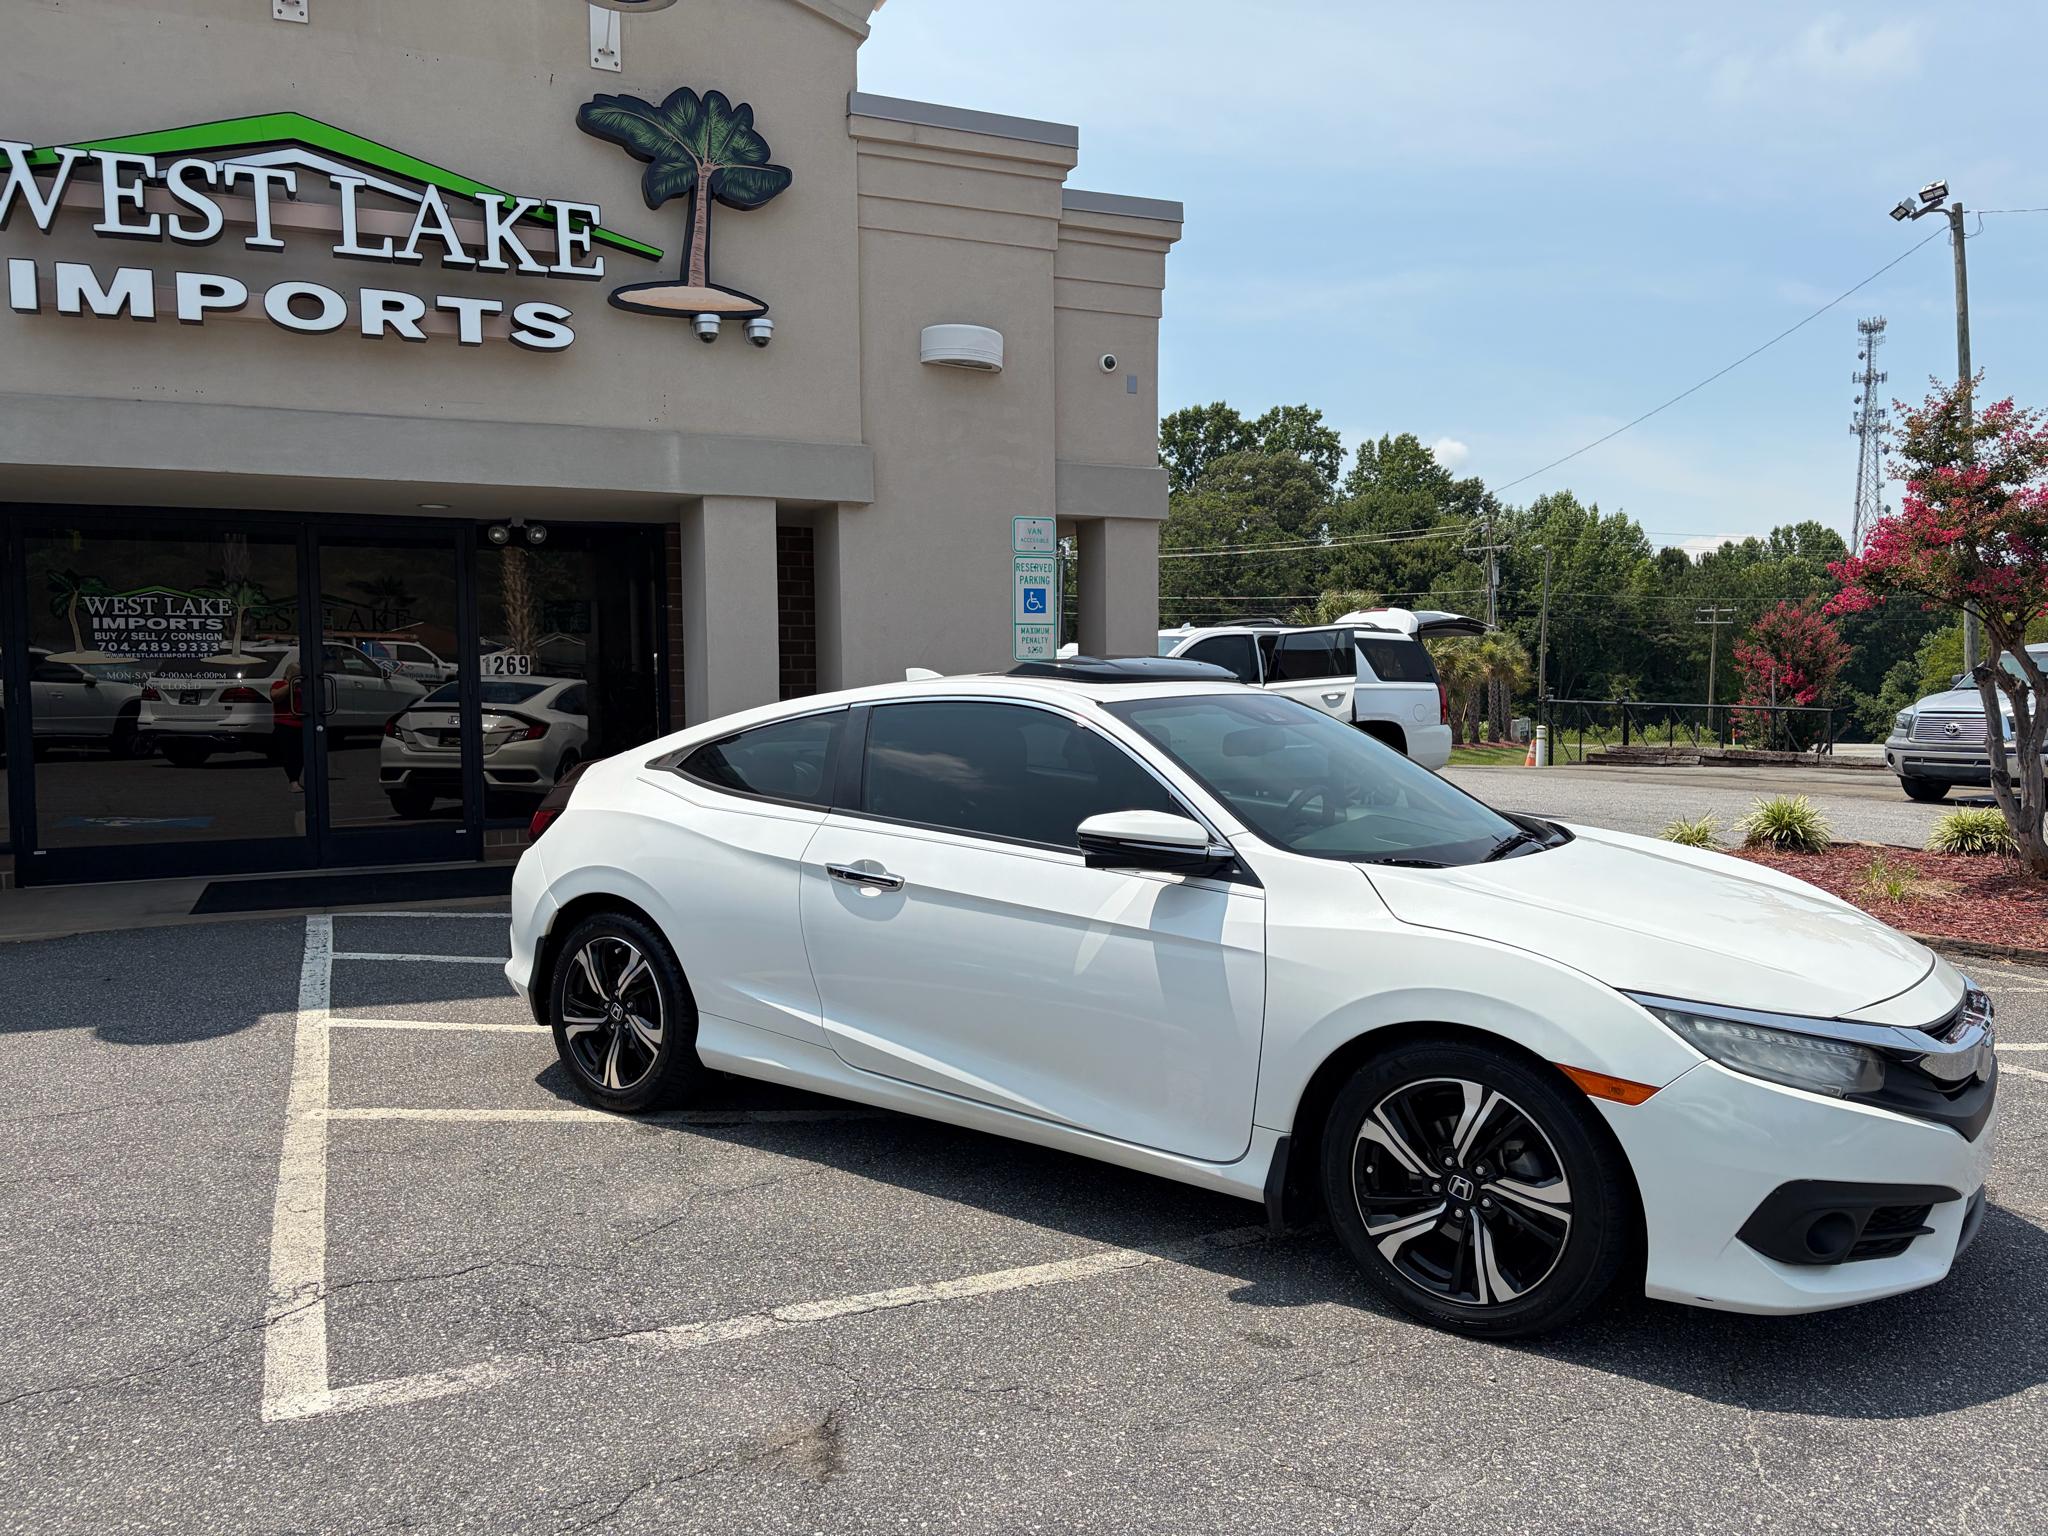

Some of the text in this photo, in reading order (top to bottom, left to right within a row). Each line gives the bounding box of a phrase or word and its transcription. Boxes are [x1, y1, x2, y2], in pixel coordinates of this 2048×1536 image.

[0, 140, 605, 279] WEST LAKE
[7, 257, 576, 352] IMPORTS
[1015, 562, 1052, 573] RESERVED
[1019, 575, 1050, 585] PARKING
[82, 596, 233, 617] WEST LAKE
[92, 617, 224, 630] IMPORTS
[94, 632, 118, 641] BUY
[130, 632, 158, 641] SELL
[170, 632, 223, 641] CONSIGN
[1020, 627, 1050, 635] MAXIMUM
[1021, 636, 1049, 644] PENALTY
[97, 642, 220, 652] 704.489.9333
[482, 655, 529, 675] 1269
